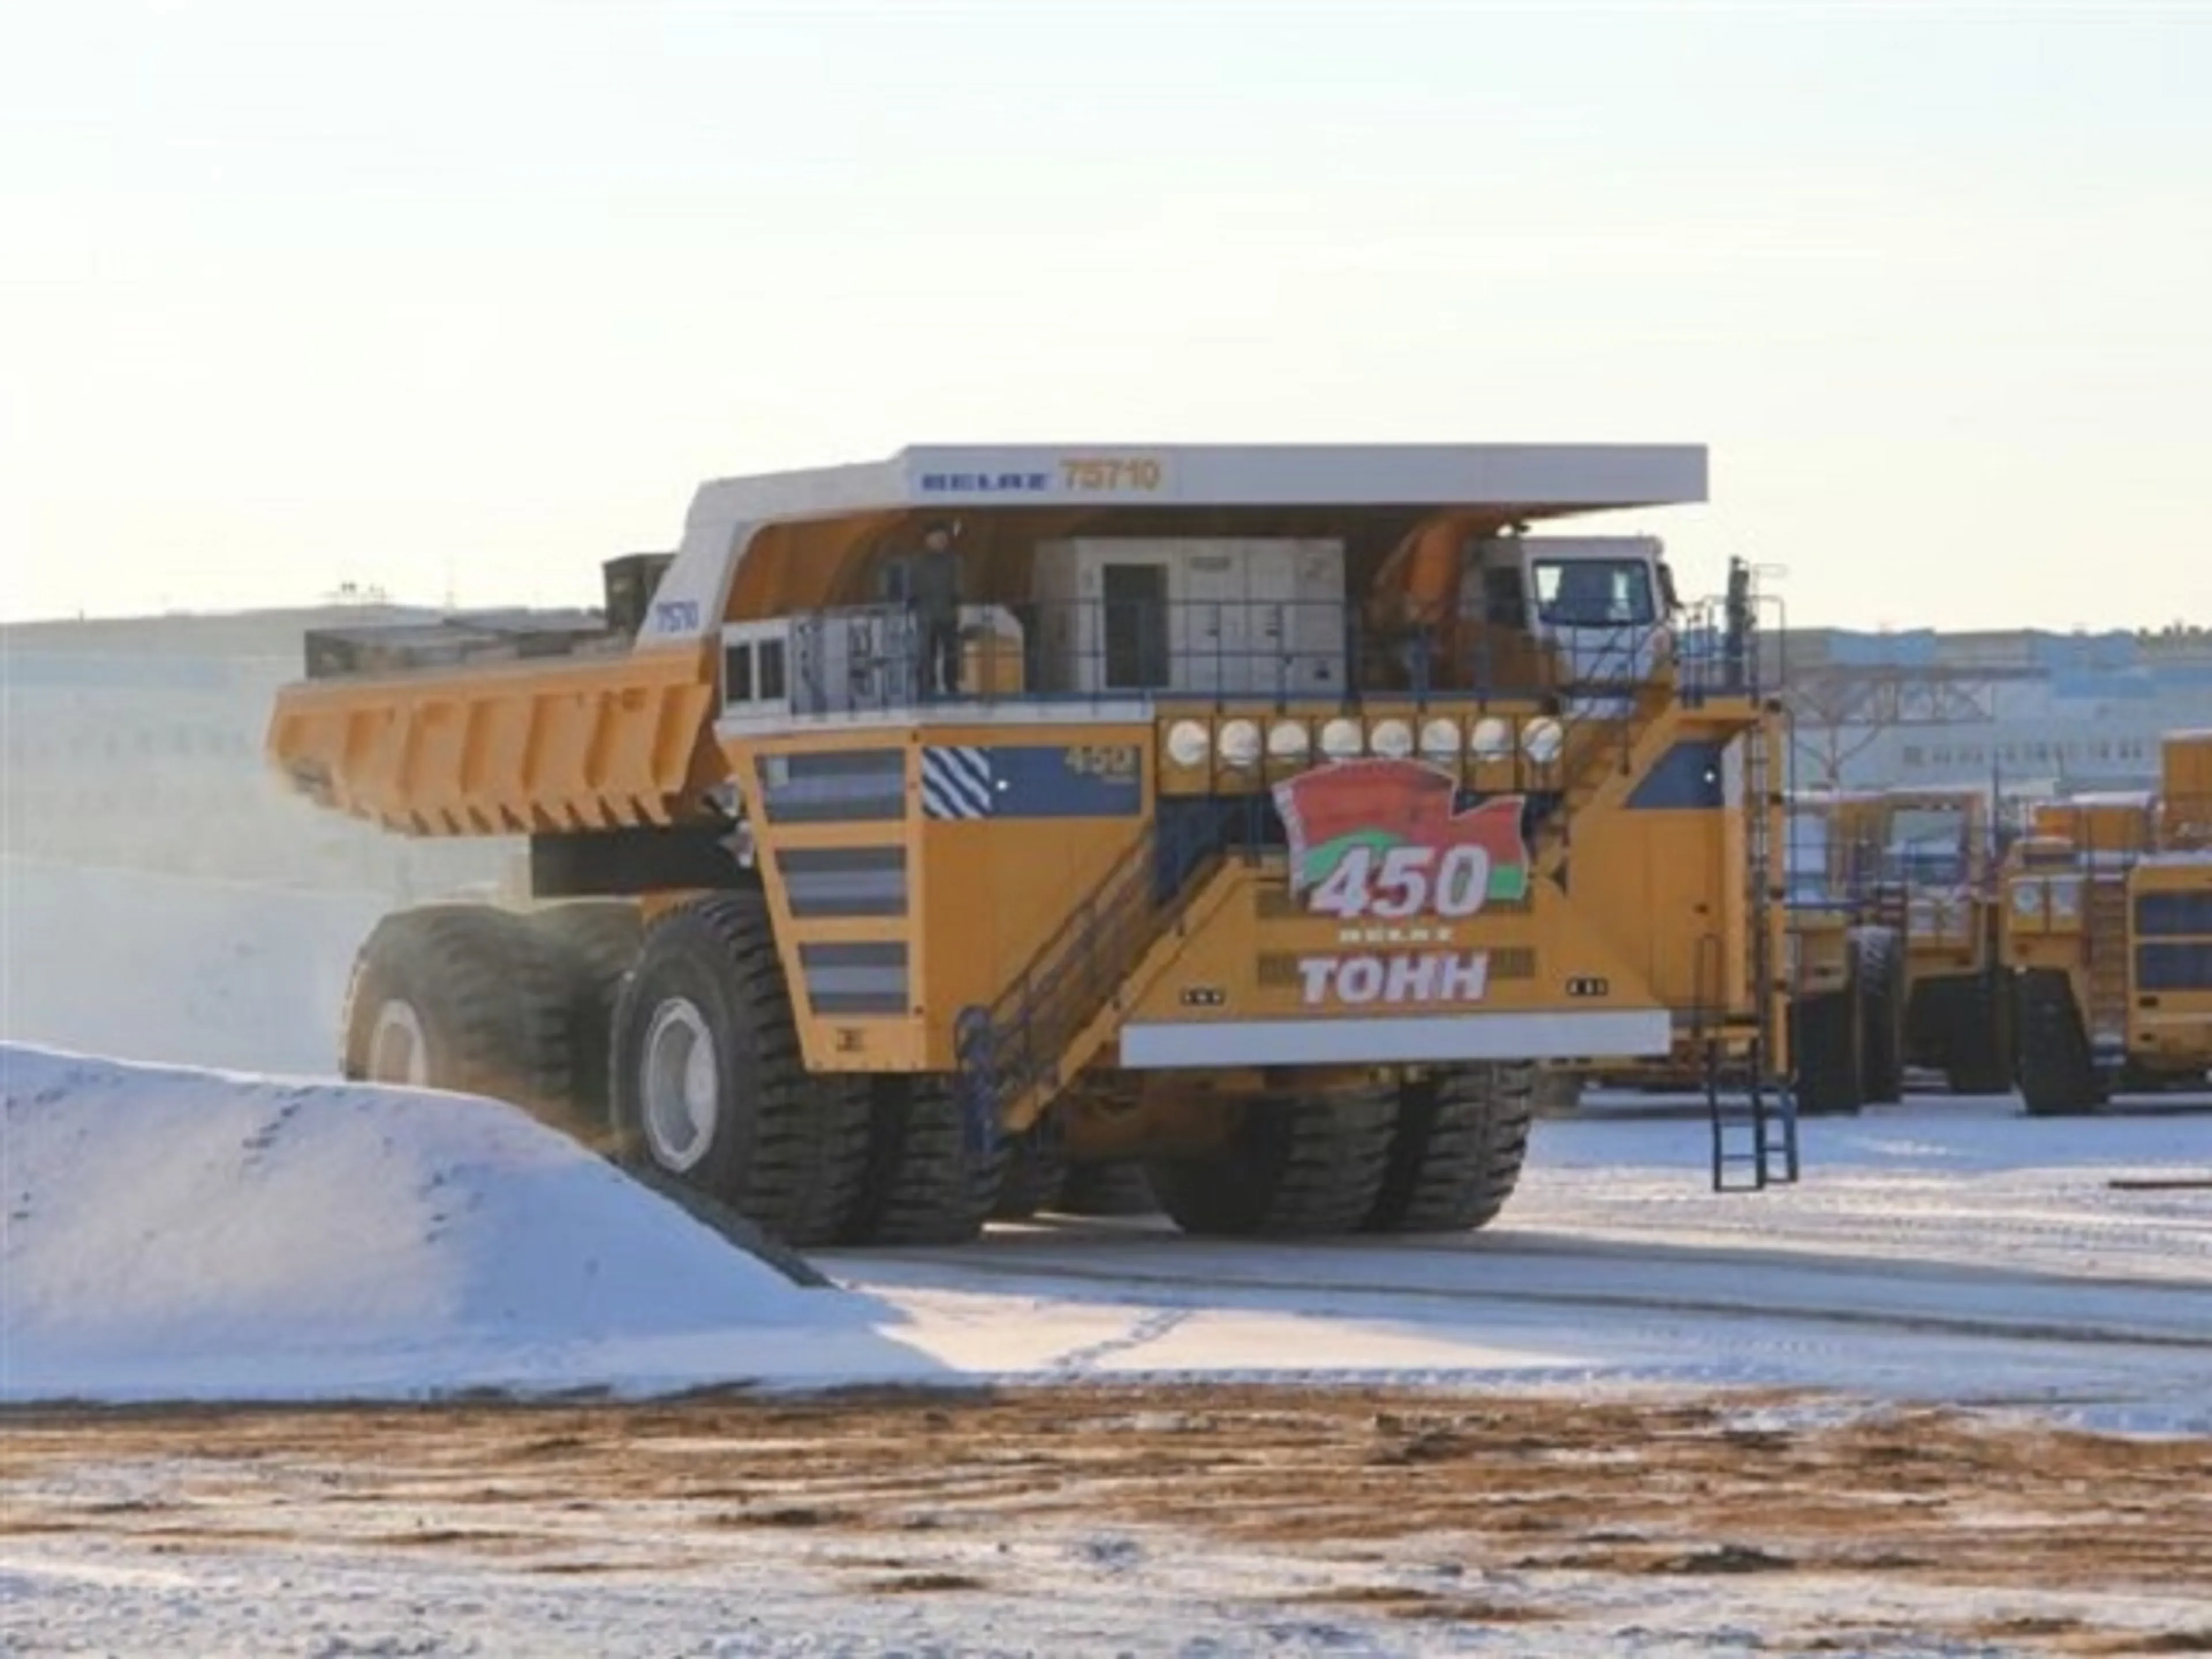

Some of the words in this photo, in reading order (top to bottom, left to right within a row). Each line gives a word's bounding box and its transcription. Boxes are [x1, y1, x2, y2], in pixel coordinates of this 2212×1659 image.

[1059, 459, 1161, 491] 75710
[1065, 747, 1137, 774] 450
[1310, 843, 1488, 917] 450
[1298, 951, 1488, 1004] ТОНН
